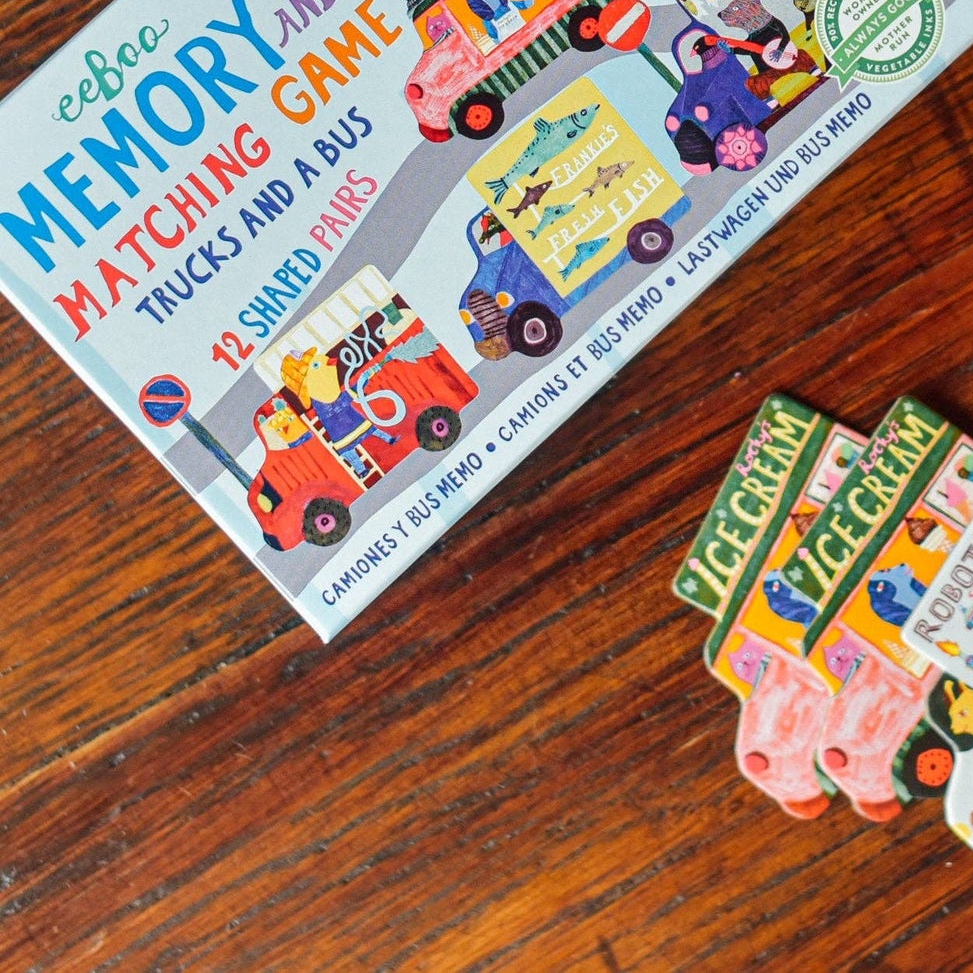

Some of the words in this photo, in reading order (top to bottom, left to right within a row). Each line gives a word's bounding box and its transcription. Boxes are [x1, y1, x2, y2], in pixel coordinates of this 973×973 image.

[828, 23, 838, 41] 90%
[844, 13, 887, 58] ALWAYS
[866, 41, 926, 72] VEGETABLE
[923, 9, 933, 37] INKS
[874, 15, 913, 52] MOTHER
[890, 31, 911, 51] RUN
[550, 124, 619, 188] FRANKIE'S
[53, 123, 271, 342] MATCHING
[136, 226, 242, 324] TRUCKS
[239, 179, 294, 239] AND
[294, 157, 320, 188] A
[314, 106, 373, 167] BUS
[547, 204, 605, 253] FRESH
[608, 167, 664, 225] FISH
[212, 332, 255, 371] 12
[238, 249, 321, 338] SHAPED
[310, 169, 378, 252] PAIRS
[322, 533, 397, 606] CAMIONES
[392, 520, 409, 538] Y
[405, 492, 440, 528] BUS
[436, 452, 483, 498] MEMO
[499, 374, 568, 441] CAMIONS
[566, 355, 588, 379] ET
[586, 326, 622, 360] BUS
[616, 286, 663, 331] MEMO
[678, 187, 769, 275] LASTWAGEN
[764, 159, 799, 193] UND
[796, 130, 831, 165] BUS
[826, 92, 872, 137] MEMO
[688, 521, 753, 598] ICE
[729, 410, 812, 527] CREAM
[798, 515, 866, 592] ICE
[847, 413, 940, 525] CREAM
